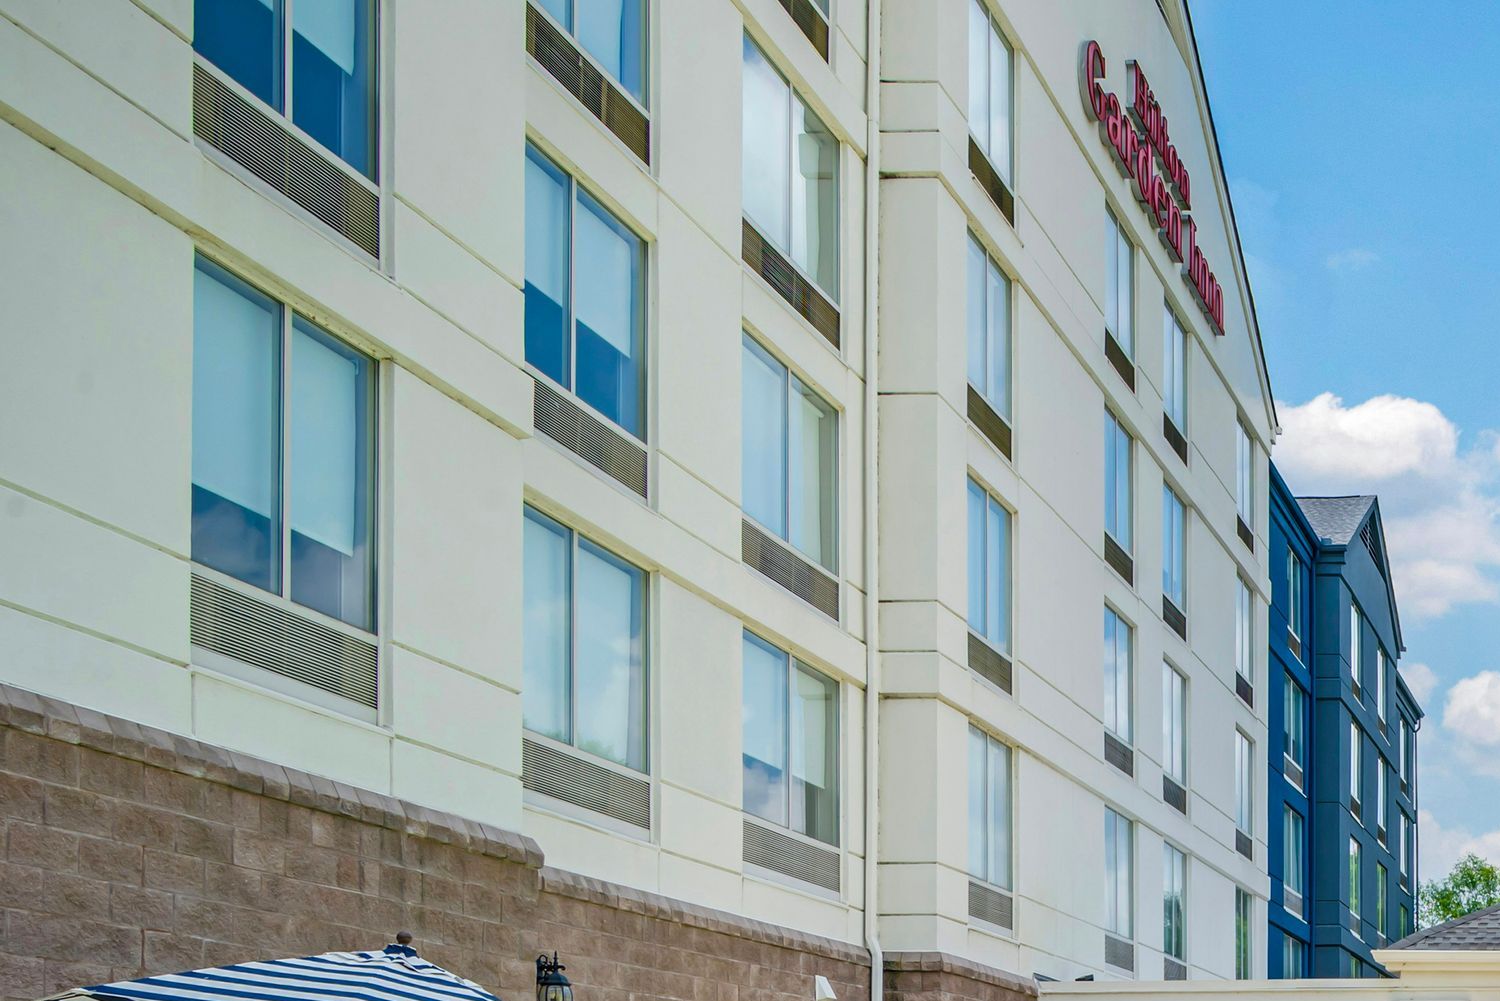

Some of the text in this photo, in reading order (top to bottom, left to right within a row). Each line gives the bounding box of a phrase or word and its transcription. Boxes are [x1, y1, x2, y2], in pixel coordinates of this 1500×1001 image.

[1080, 40, 1225, 336] Garden Inn
[1130, 60, 1191, 211] Hilton
